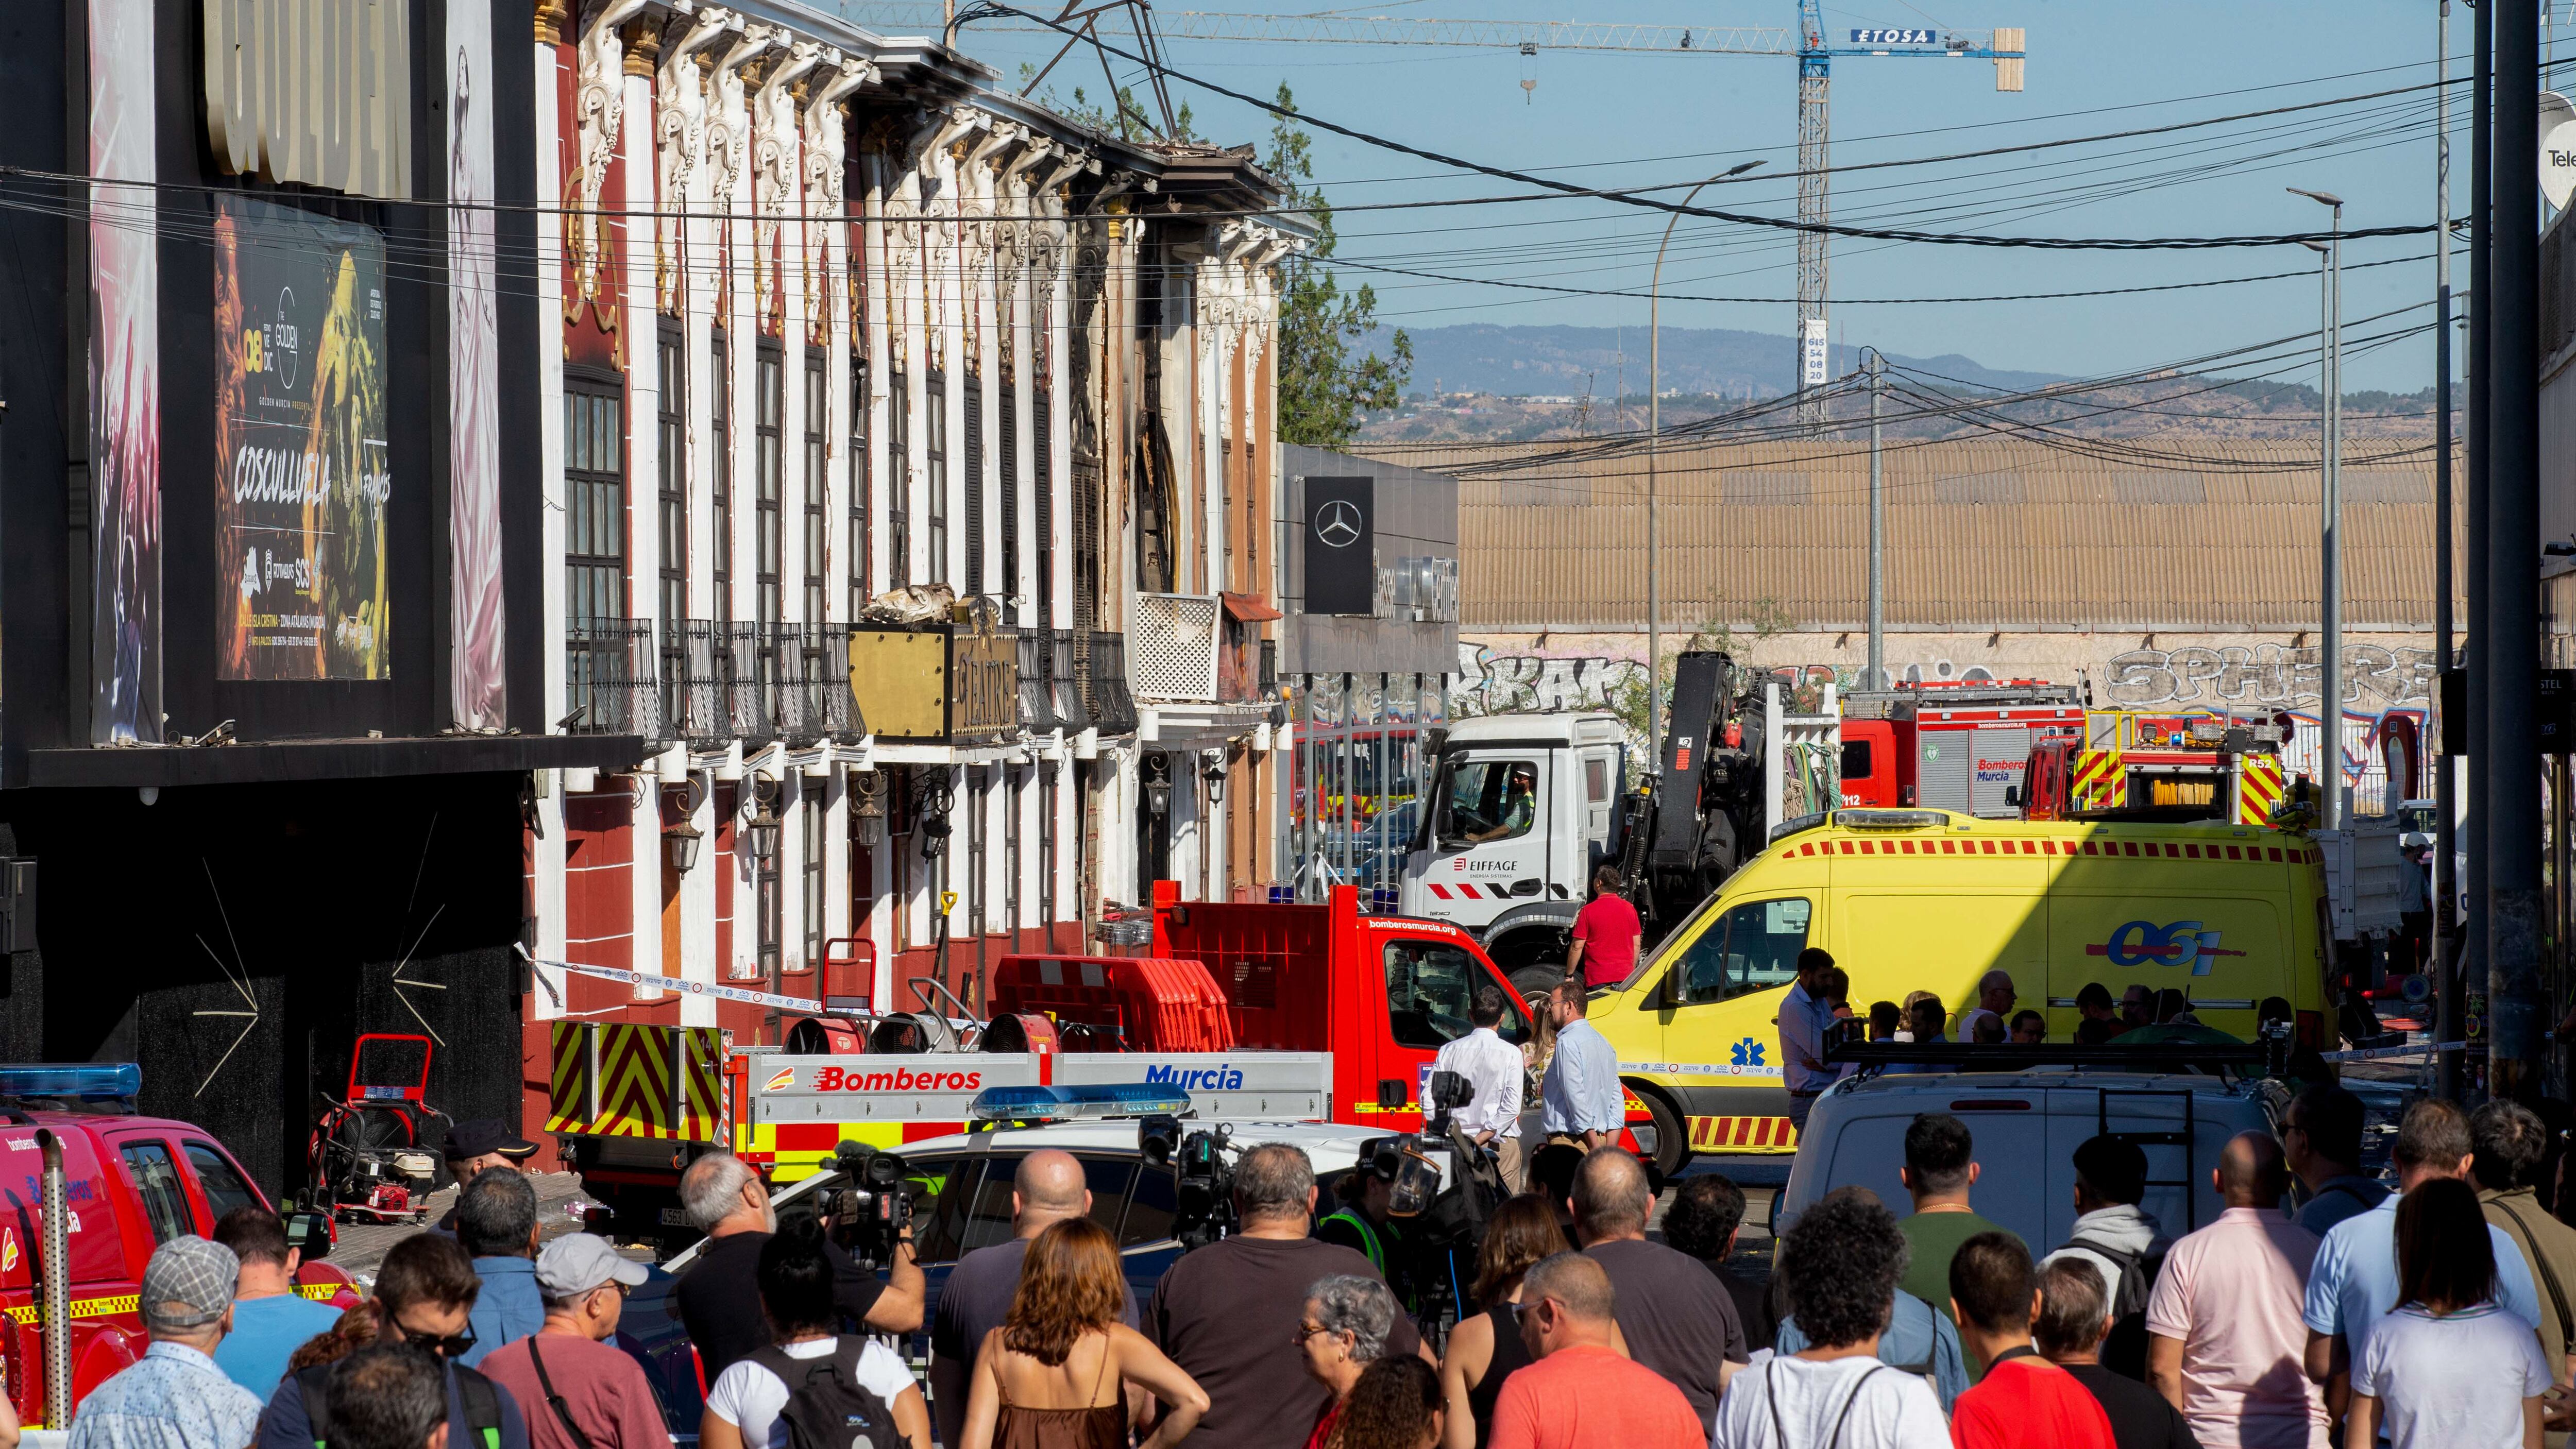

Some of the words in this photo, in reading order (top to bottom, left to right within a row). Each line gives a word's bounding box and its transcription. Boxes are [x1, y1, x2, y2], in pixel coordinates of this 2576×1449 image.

[1859, 29, 1928, 43] ETOSA
[275, 323, 298, 350] GOLDEN
[243, 329, 264, 373] 08
[1810, 349, 1823, 357] 54
[264, 351, 273, 372] DIC
[1810, 360, 1822, 368] 08
[1810, 371, 1822, 380] 20
[259, 396, 275, 408] GOLDEN
[276, 398, 291, 408] MURCIA
[295, 557, 310, 588] SCS
[239, 613, 252, 627] CALLE
[261, 614, 278, 627] CRISTINA
[280, 614, 291, 628] ZONA
[959, 645, 1011, 727] TEATRE
[2540, 679, 2563, 689] STEL
[1675, 749, 1690, 770] HIAB
[2248, 758, 2272, 769] R52
[1977, 771, 2009, 781] Murcia
[1469, 861, 1518, 871] EIFFAGE
[1369, 919, 1457, 935] bomberosmurcia.org
[2107, 920, 2223, 976] 061
[694, 1036, 712, 1051] L14
[815, 1066, 981, 1092] Bomberos
[1146, 1064, 1244, 1090] Murcia
[663, 1209, 681, 1224] 4563
